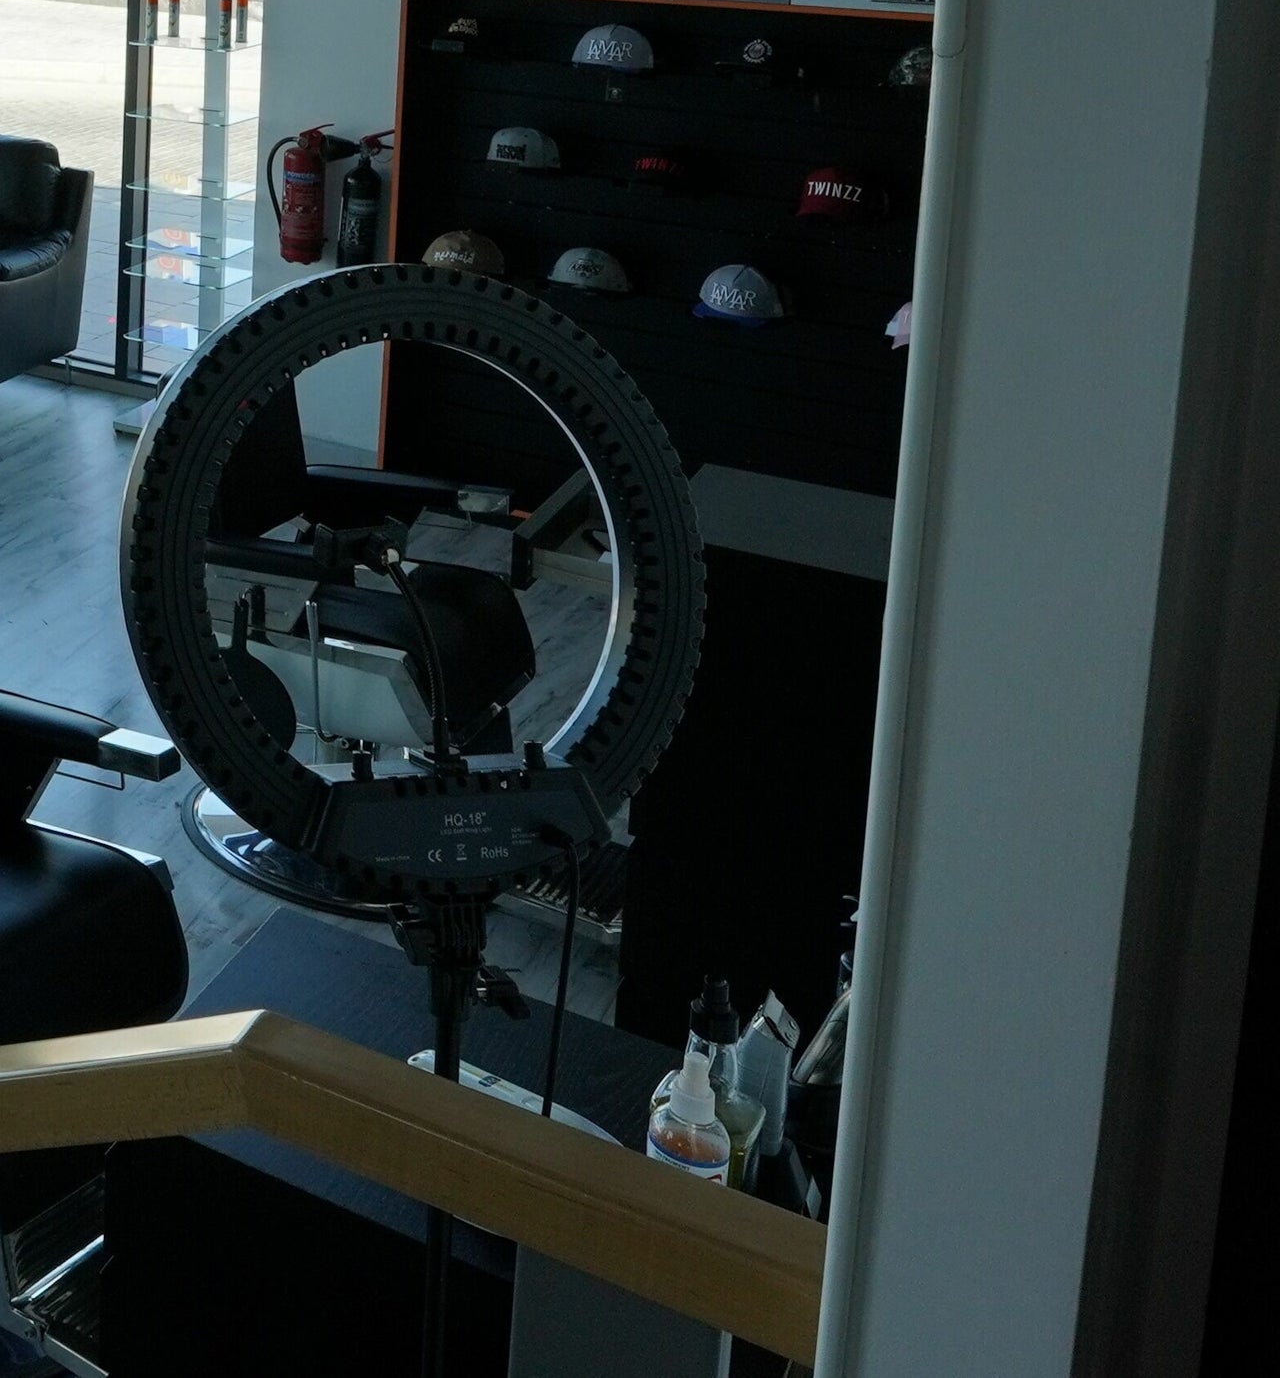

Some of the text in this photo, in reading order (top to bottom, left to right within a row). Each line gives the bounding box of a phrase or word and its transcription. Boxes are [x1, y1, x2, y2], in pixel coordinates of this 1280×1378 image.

[586, 38, 633, 62] LAMAR
[807, 180, 863, 203] TWINZZ
[711, 281, 757, 311] LAMAR
[444, 811, 487, 827] HQ-18"
